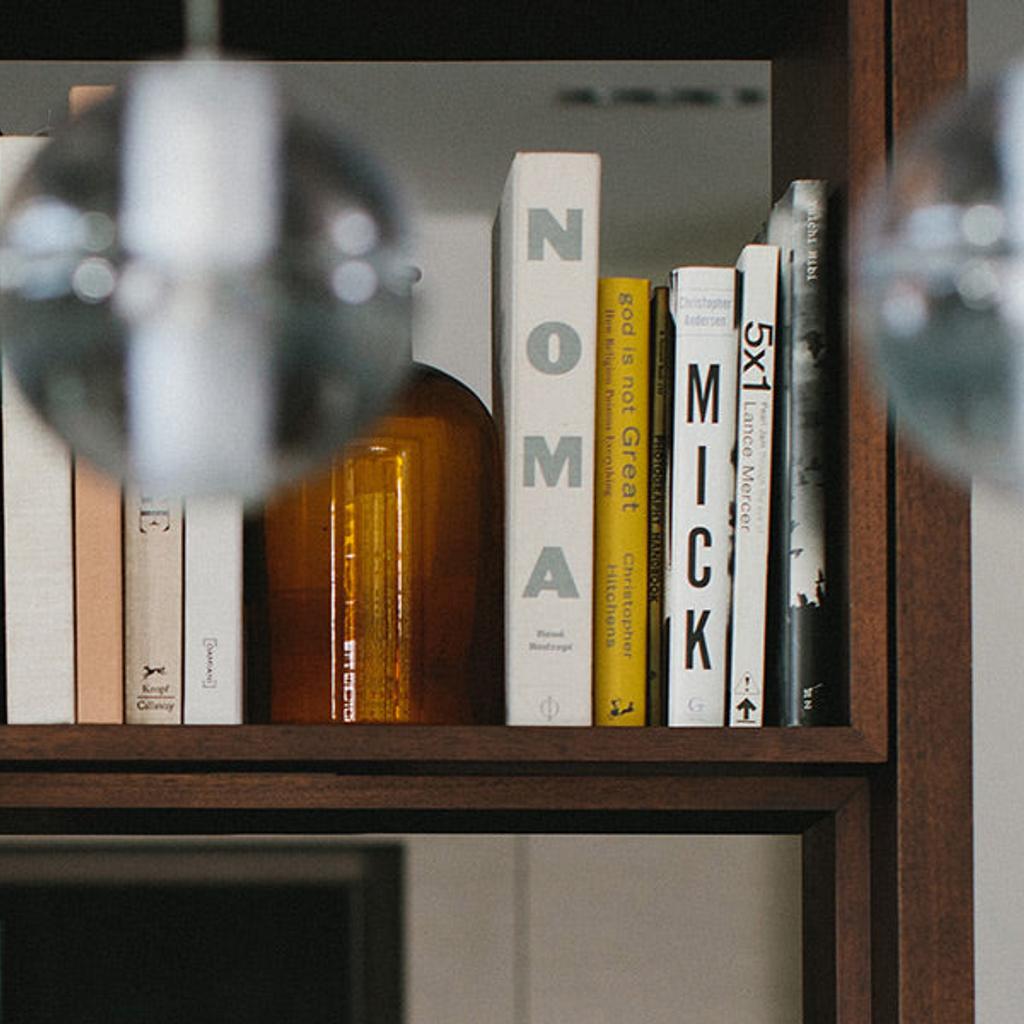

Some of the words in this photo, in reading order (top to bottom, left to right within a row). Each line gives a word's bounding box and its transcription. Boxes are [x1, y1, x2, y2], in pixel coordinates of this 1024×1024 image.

[618, 292, 636, 337] god
[621, 347, 635, 365] is
[621, 375, 635, 415] not
[742, 401, 757, 457] Lance
[621, 425, 641, 513] Great
[685, 363, 720, 670] MICK
[740, 465, 756, 534] Mercer
